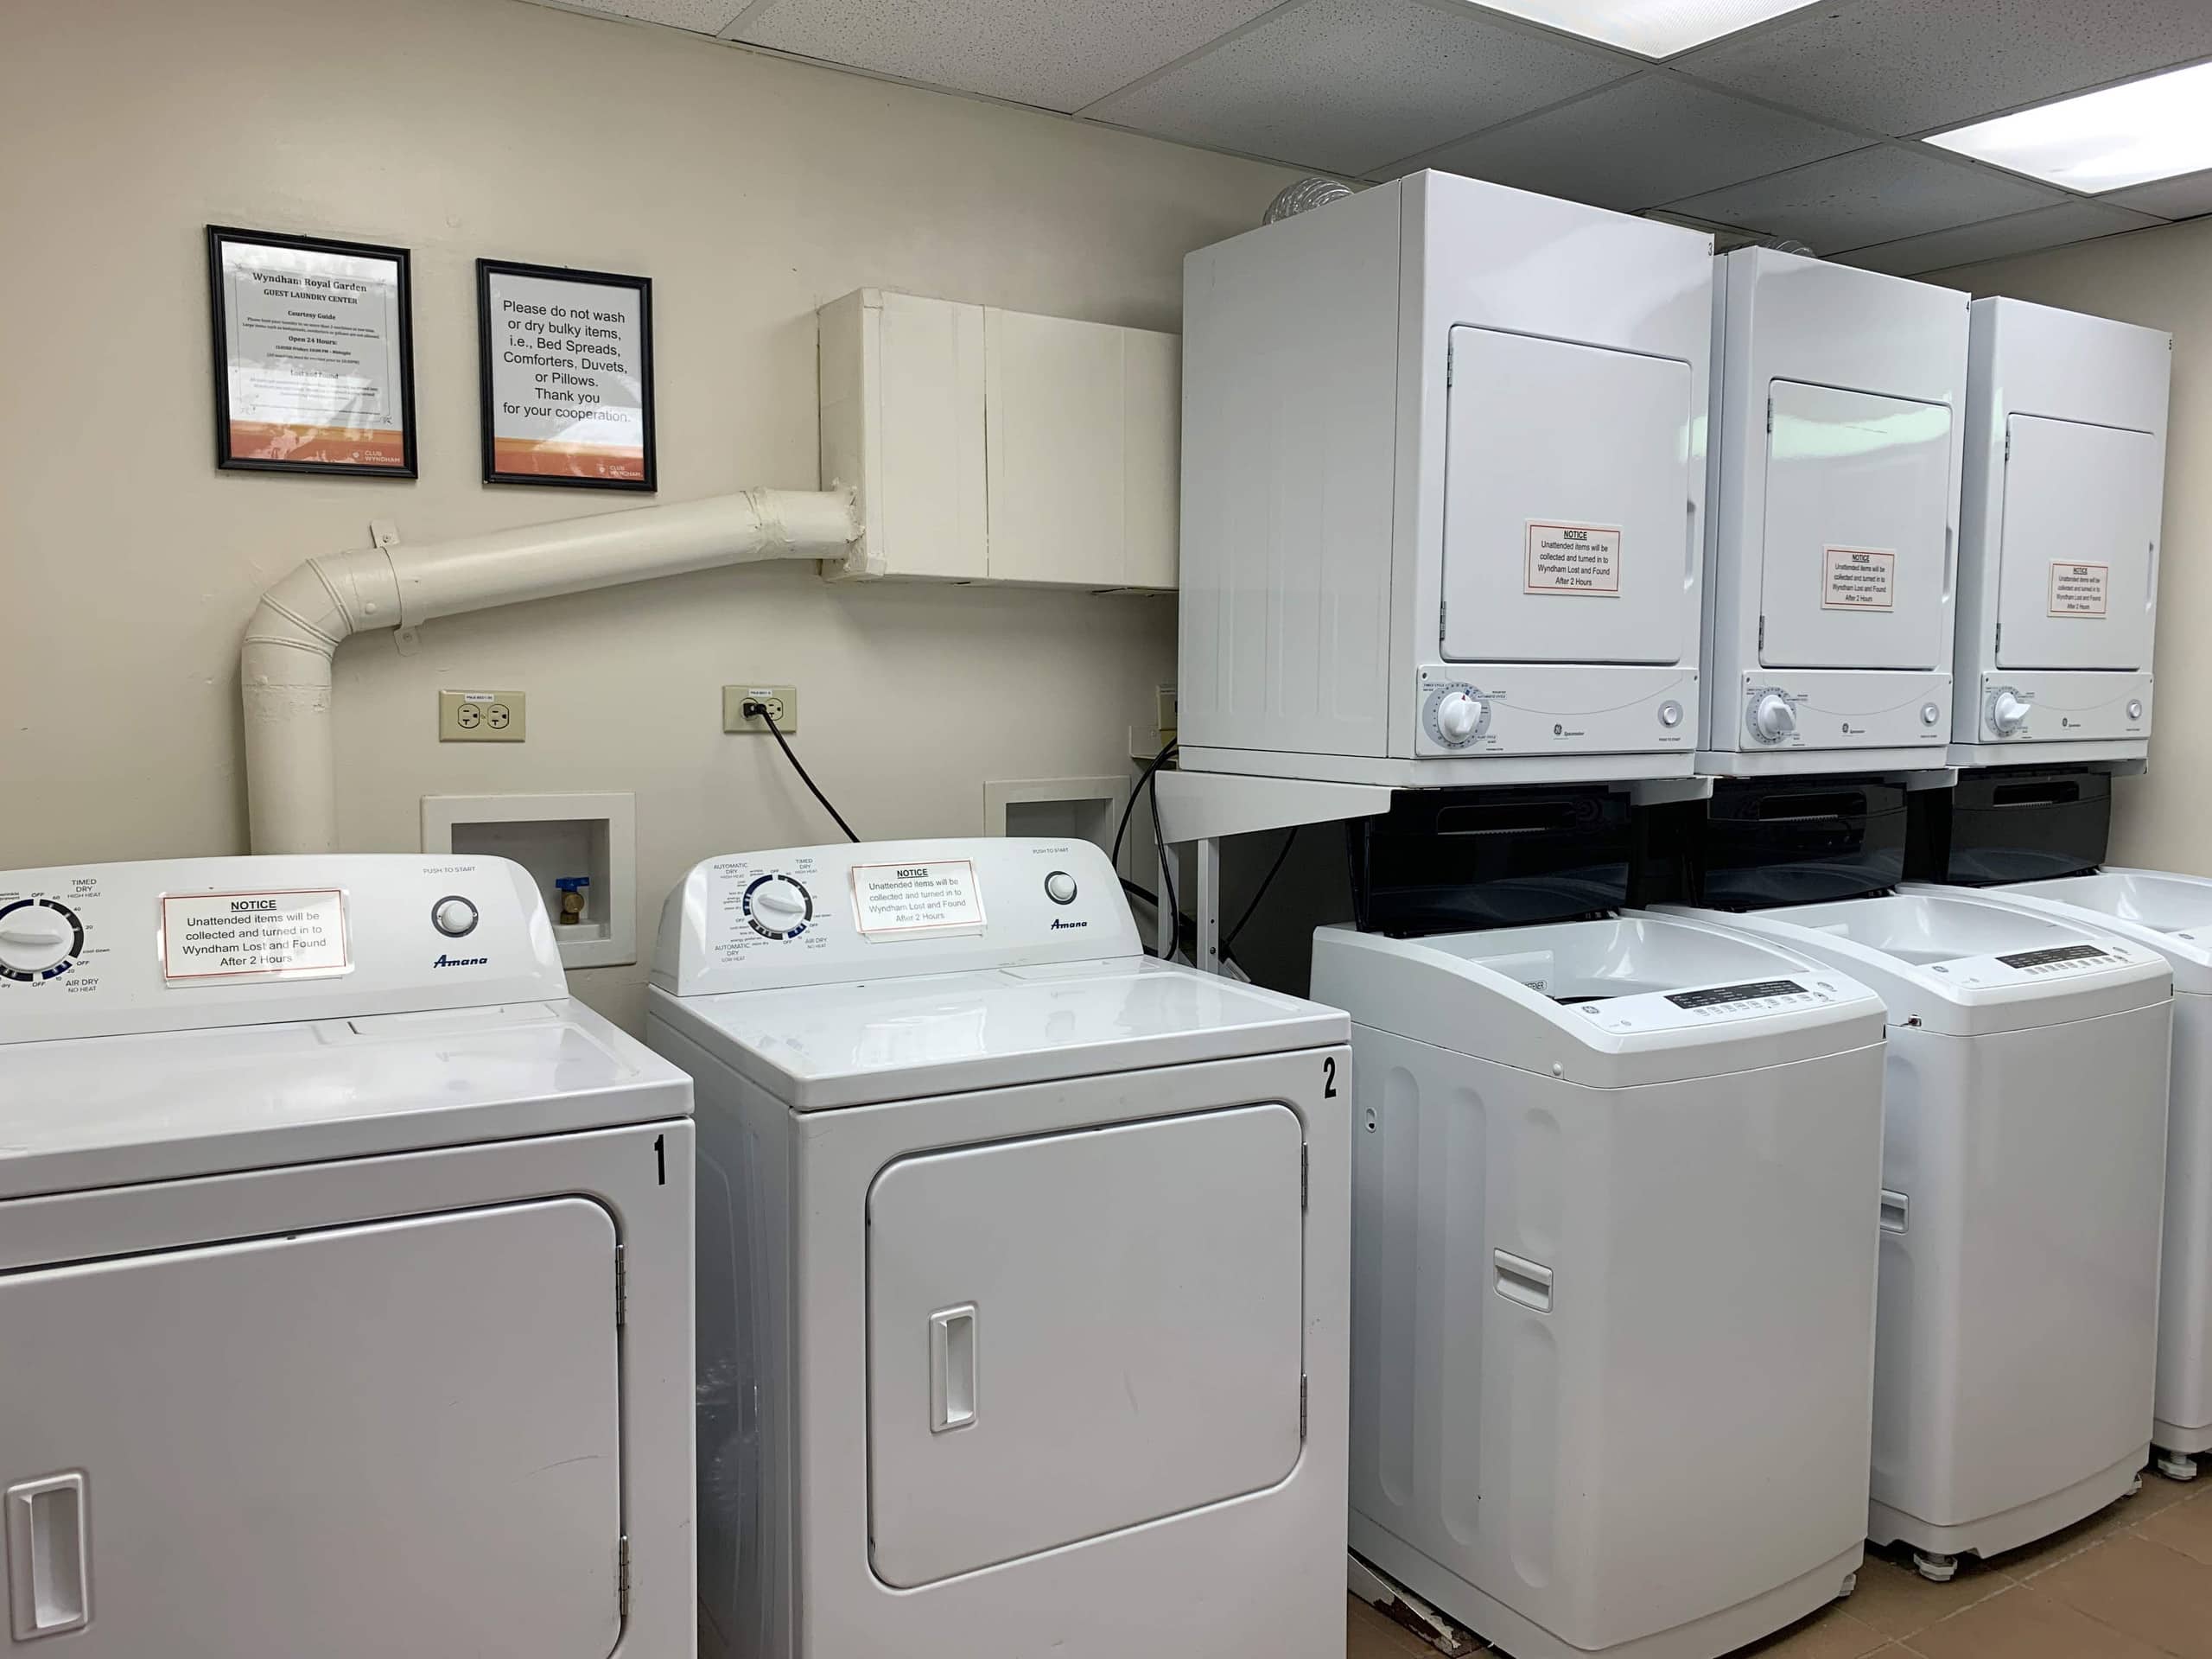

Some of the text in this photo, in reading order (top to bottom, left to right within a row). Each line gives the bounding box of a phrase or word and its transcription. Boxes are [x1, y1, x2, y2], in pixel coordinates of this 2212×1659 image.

[252, 272, 366, 292] Wyndham Royal Garden
[290, 291, 327, 301] LAUNDRY
[328, 296, 357, 304] CENTER
[288, 310, 315, 319] Courtesy
[504, 300, 625, 323] Please do not wash
[508, 320, 621, 340] or dry bulky items,
[510, 335, 620, 357] i.e., Bed Spreads,
[504, 352, 627, 373] Comforters, Duvets,
[535, 372, 599, 387] or Pillows.
[535, 388, 600, 404] Thank you
[504, 403, 630, 422] for your cooperation.
[1541, 541, 1573, 550] Unattended
[1538, 564, 1567, 573] Wyndham
[897, 868, 928, 877] NOTICE
[869, 881, 912, 890] Unattended
[870, 893, 903, 901] collected
[231, 900, 276, 910] NOTICE
[869, 904, 907, 914] Wyndham
[187, 915, 251, 926] Unattended
[255, 913, 283, 924] items
[287, 912, 303, 922] will
[1051, 919, 1087, 930] Amana
[186, 930, 235, 941] collected
[238, 928, 258, 938] and
[262, 926, 296, 937] turned
[182, 944, 238, 957] Wyndham
[243, 942, 266, 951] Lost
[293, 939, 326, 948] Found
[220, 957, 246, 966] After
[260, 955, 292, 963] Hours
[434, 955, 487, 968] Amana
[1324, 1057, 1336, 1099] 2
[654, 1134, 664, 1185] 1
